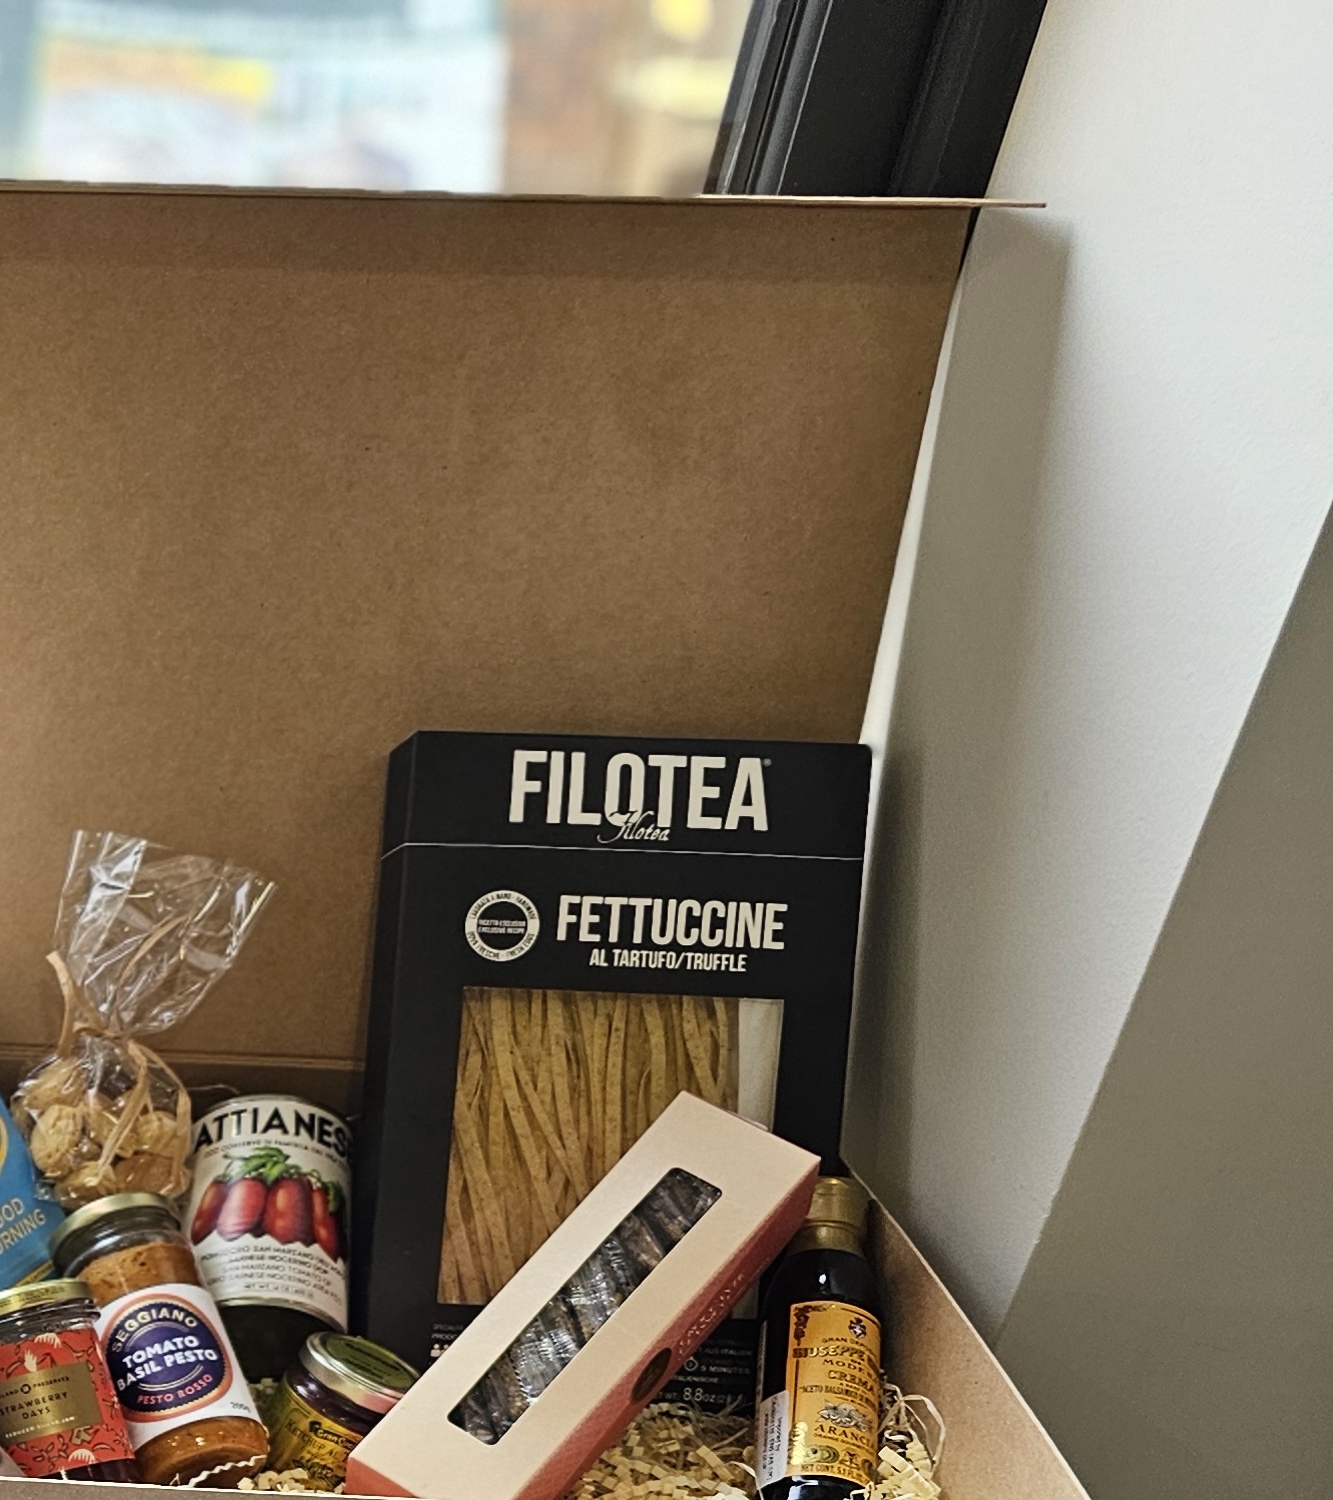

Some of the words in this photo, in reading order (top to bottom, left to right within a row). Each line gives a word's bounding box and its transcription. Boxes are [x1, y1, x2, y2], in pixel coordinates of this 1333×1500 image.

[508, 749, 769, 831] FILOTEA
[597, 810, 671, 843] Filotea
[556, 894, 788, 950] FETTUCCINE
[589, 948, 608, 967] AL
[612, 949, 748, 972] TARTUFO/TRUFFLE
[112, 1307, 198, 1353] SEGGIANO
[122, 1335, 199, 1369] TOMATO
[117, 1360, 163, 1391] BASIL
[164, 1349, 218, 1368] PESTO
[0, 1391, 69, 1417] STRAWBERRY
[136, 1392, 175, 1405] PESTO
[177, 1373, 214, 1399] ROSSO
[22, 1406, 51, 1420] DAYS
